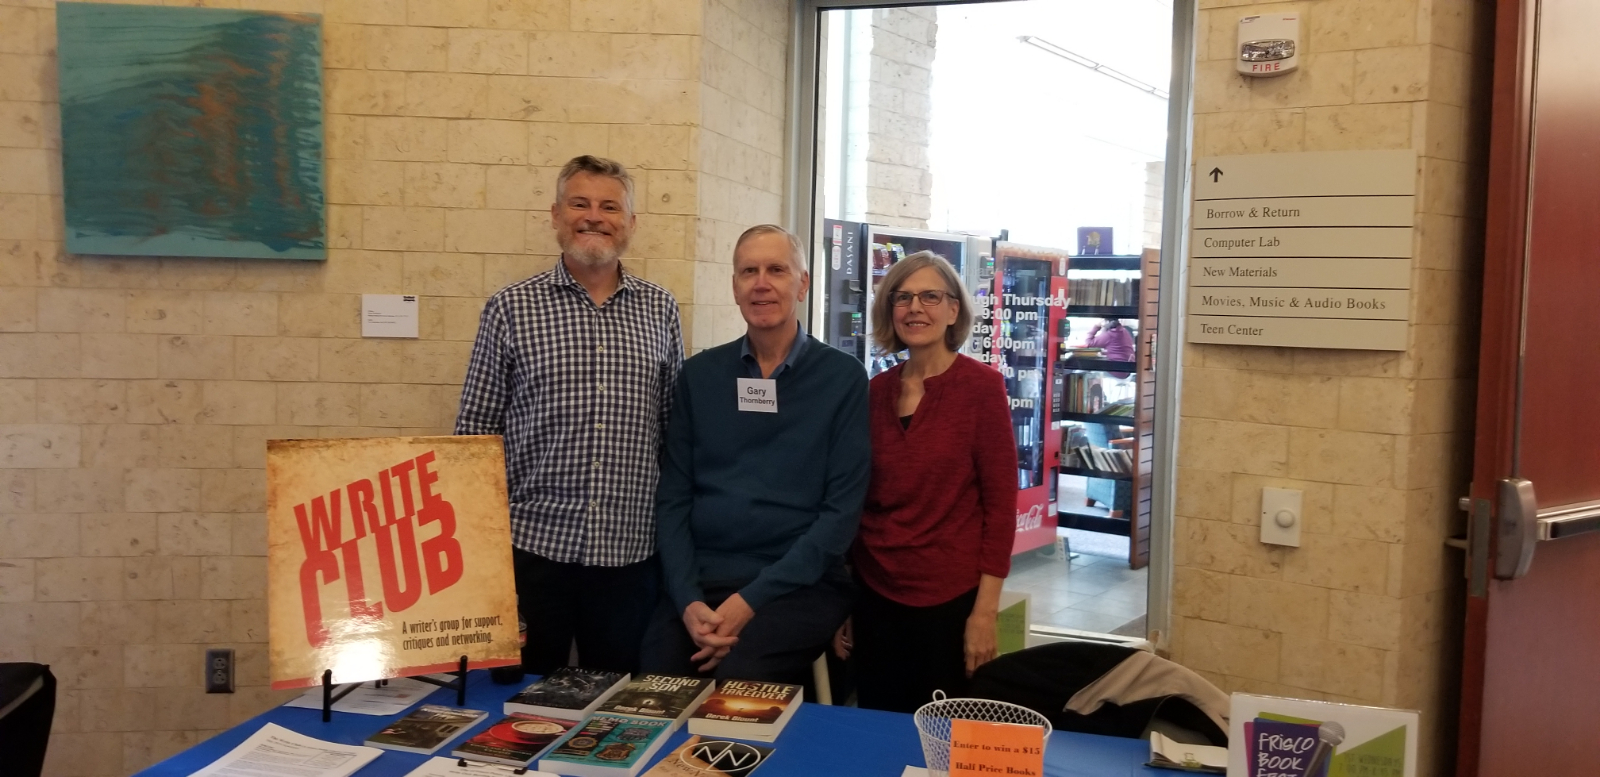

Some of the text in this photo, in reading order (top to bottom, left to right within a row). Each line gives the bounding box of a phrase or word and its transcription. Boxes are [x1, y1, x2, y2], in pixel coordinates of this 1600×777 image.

[1252, 62, 1280, 72] FIRE
[1206, 206, 1300, 219] Borrow & Return
[1203, 236, 1281, 250] Computer Lab
[846, 231, 854, 275] DASANI
[1202, 266, 1278, 277] New Materials
[1002, 293, 1071, 309] Thursday
[1201, 295, 1386, 310] Movies, Music & Audio Books
[982, 308, 1038, 323] 9:00 pm
[1200, 323, 1264, 336] Teen Center
[746, 386, 767, 397] Gary
[739, 396, 776, 407] Thornberry
[293, 450, 443, 556] WRITE
[299, 500, 464, 648] CLUB
[402, 621, 408, 634] A
[409, 618, 438, 634] writer's
[440, 619, 460, 632] group
[462, 616, 472, 630] for
[403, 636, 434, 650] critiques
[436, 633, 450, 647] and
[643, 674, 701, 687] SECOND
[648, 682, 681, 692] SON
[724, 680, 795, 695] HOSTILE
[720, 688, 788, 700] TAKEOVER
[630, 719, 668, 727] BOOK
[705, 712, 759, 723] Derek Blount
[953, 740, 980, 750] Enter
[982, 743, 991, 751] to
[994, 744, 1012, 753] win
[1022, 746, 1041, 755] $15
[1257, 752, 1304, 771] BOOK
[955, 762, 1036, 777] Half Price Books
